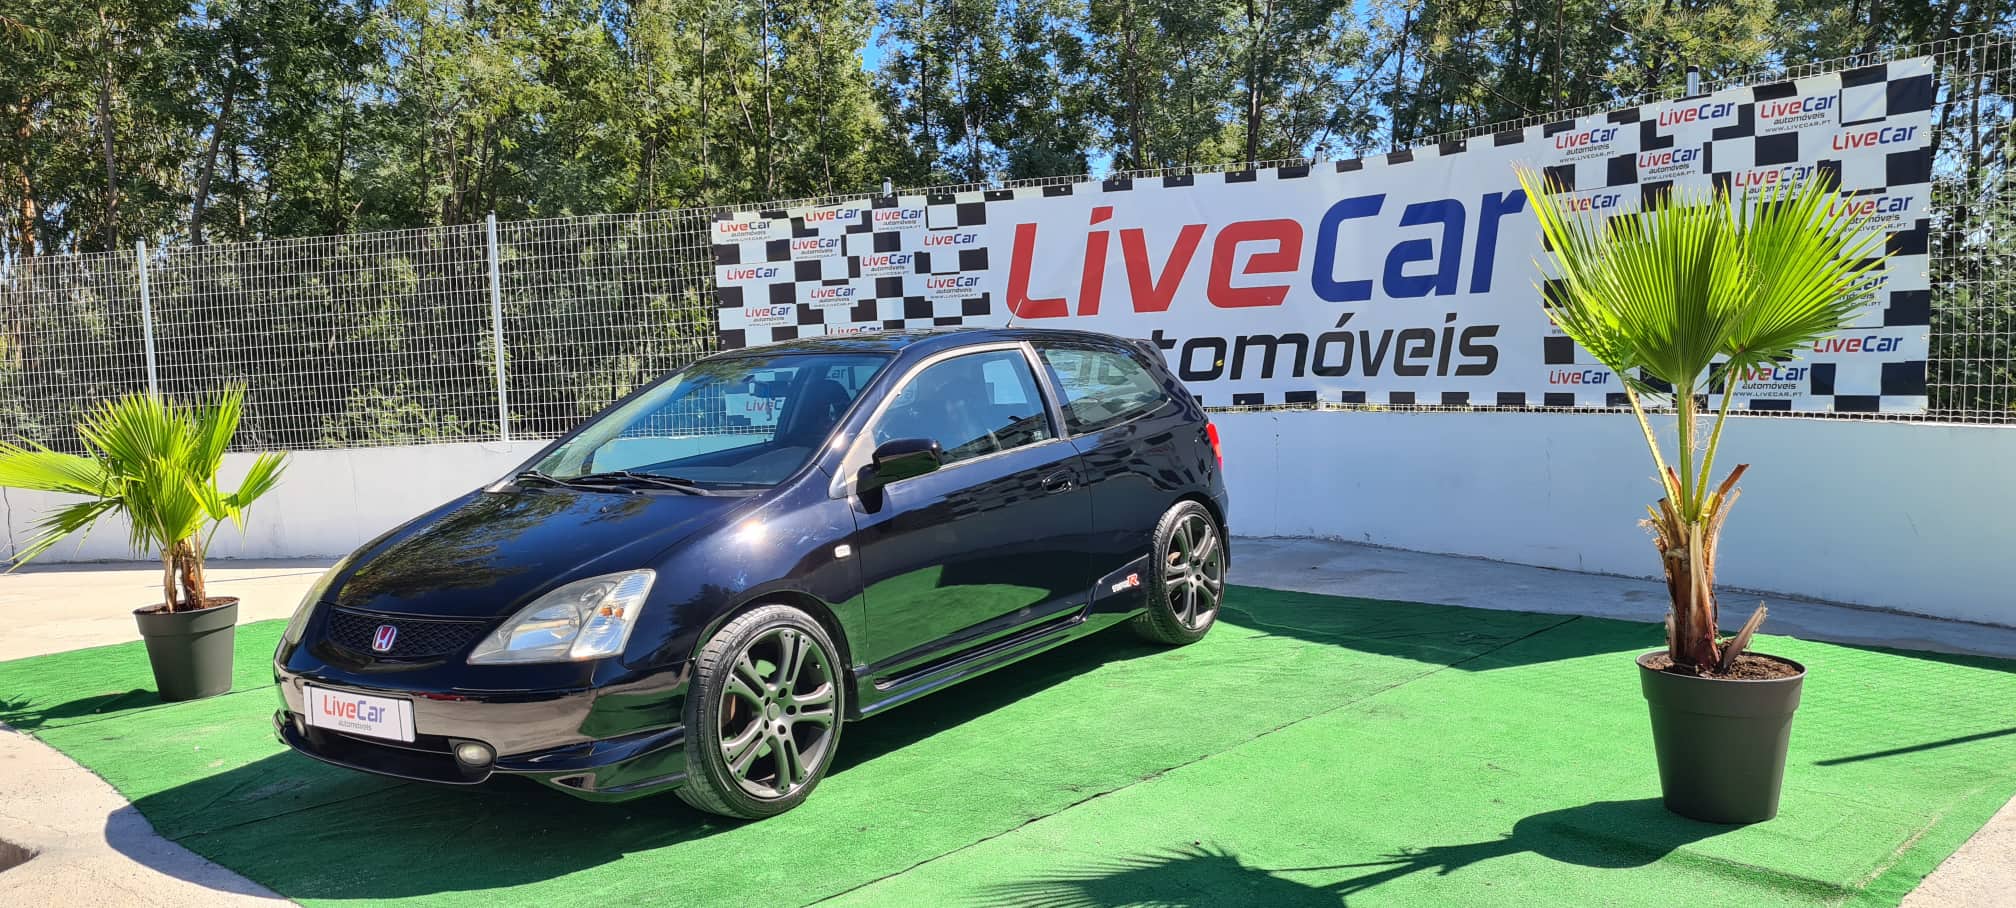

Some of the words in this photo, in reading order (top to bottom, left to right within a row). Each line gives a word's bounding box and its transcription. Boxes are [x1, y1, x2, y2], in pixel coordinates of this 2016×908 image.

[1760, 95, 1837, 119] LiveCar
[1659, 102, 1736, 127] LiveCar
[1773, 112, 1825, 125] automóveis
[1765, 119, 1831, 133] WWW.LIVECAR.PT
[1555, 128, 1618, 149] LiveCar
[1832, 126, 1917, 150] LiveCar
[1566, 143, 1610, 155] automóveis
[1639, 148, 1701, 168] LiveCar
[805, 208, 860, 222] LiveCar
[875, 209, 924, 221] LiveCar
[720, 221, 771, 232] LiveCar
[792, 238, 840, 250] LiveCar
[924, 233, 977, 246] LiveCar
[862, 254, 913, 267] LiveCar
[1005, 188, 1529, 320] LiveCar
[726, 266, 779, 280] LiveCar
[926, 276, 980, 289] LiveCar
[810, 287, 856, 299] LiveCar
[745, 306, 791, 317] LiveCar
[1813, 335, 1903, 353] LiveCar
[1549, 369, 1610, 384] LiveCar
[323, 694, 386, 723] LiveCar
